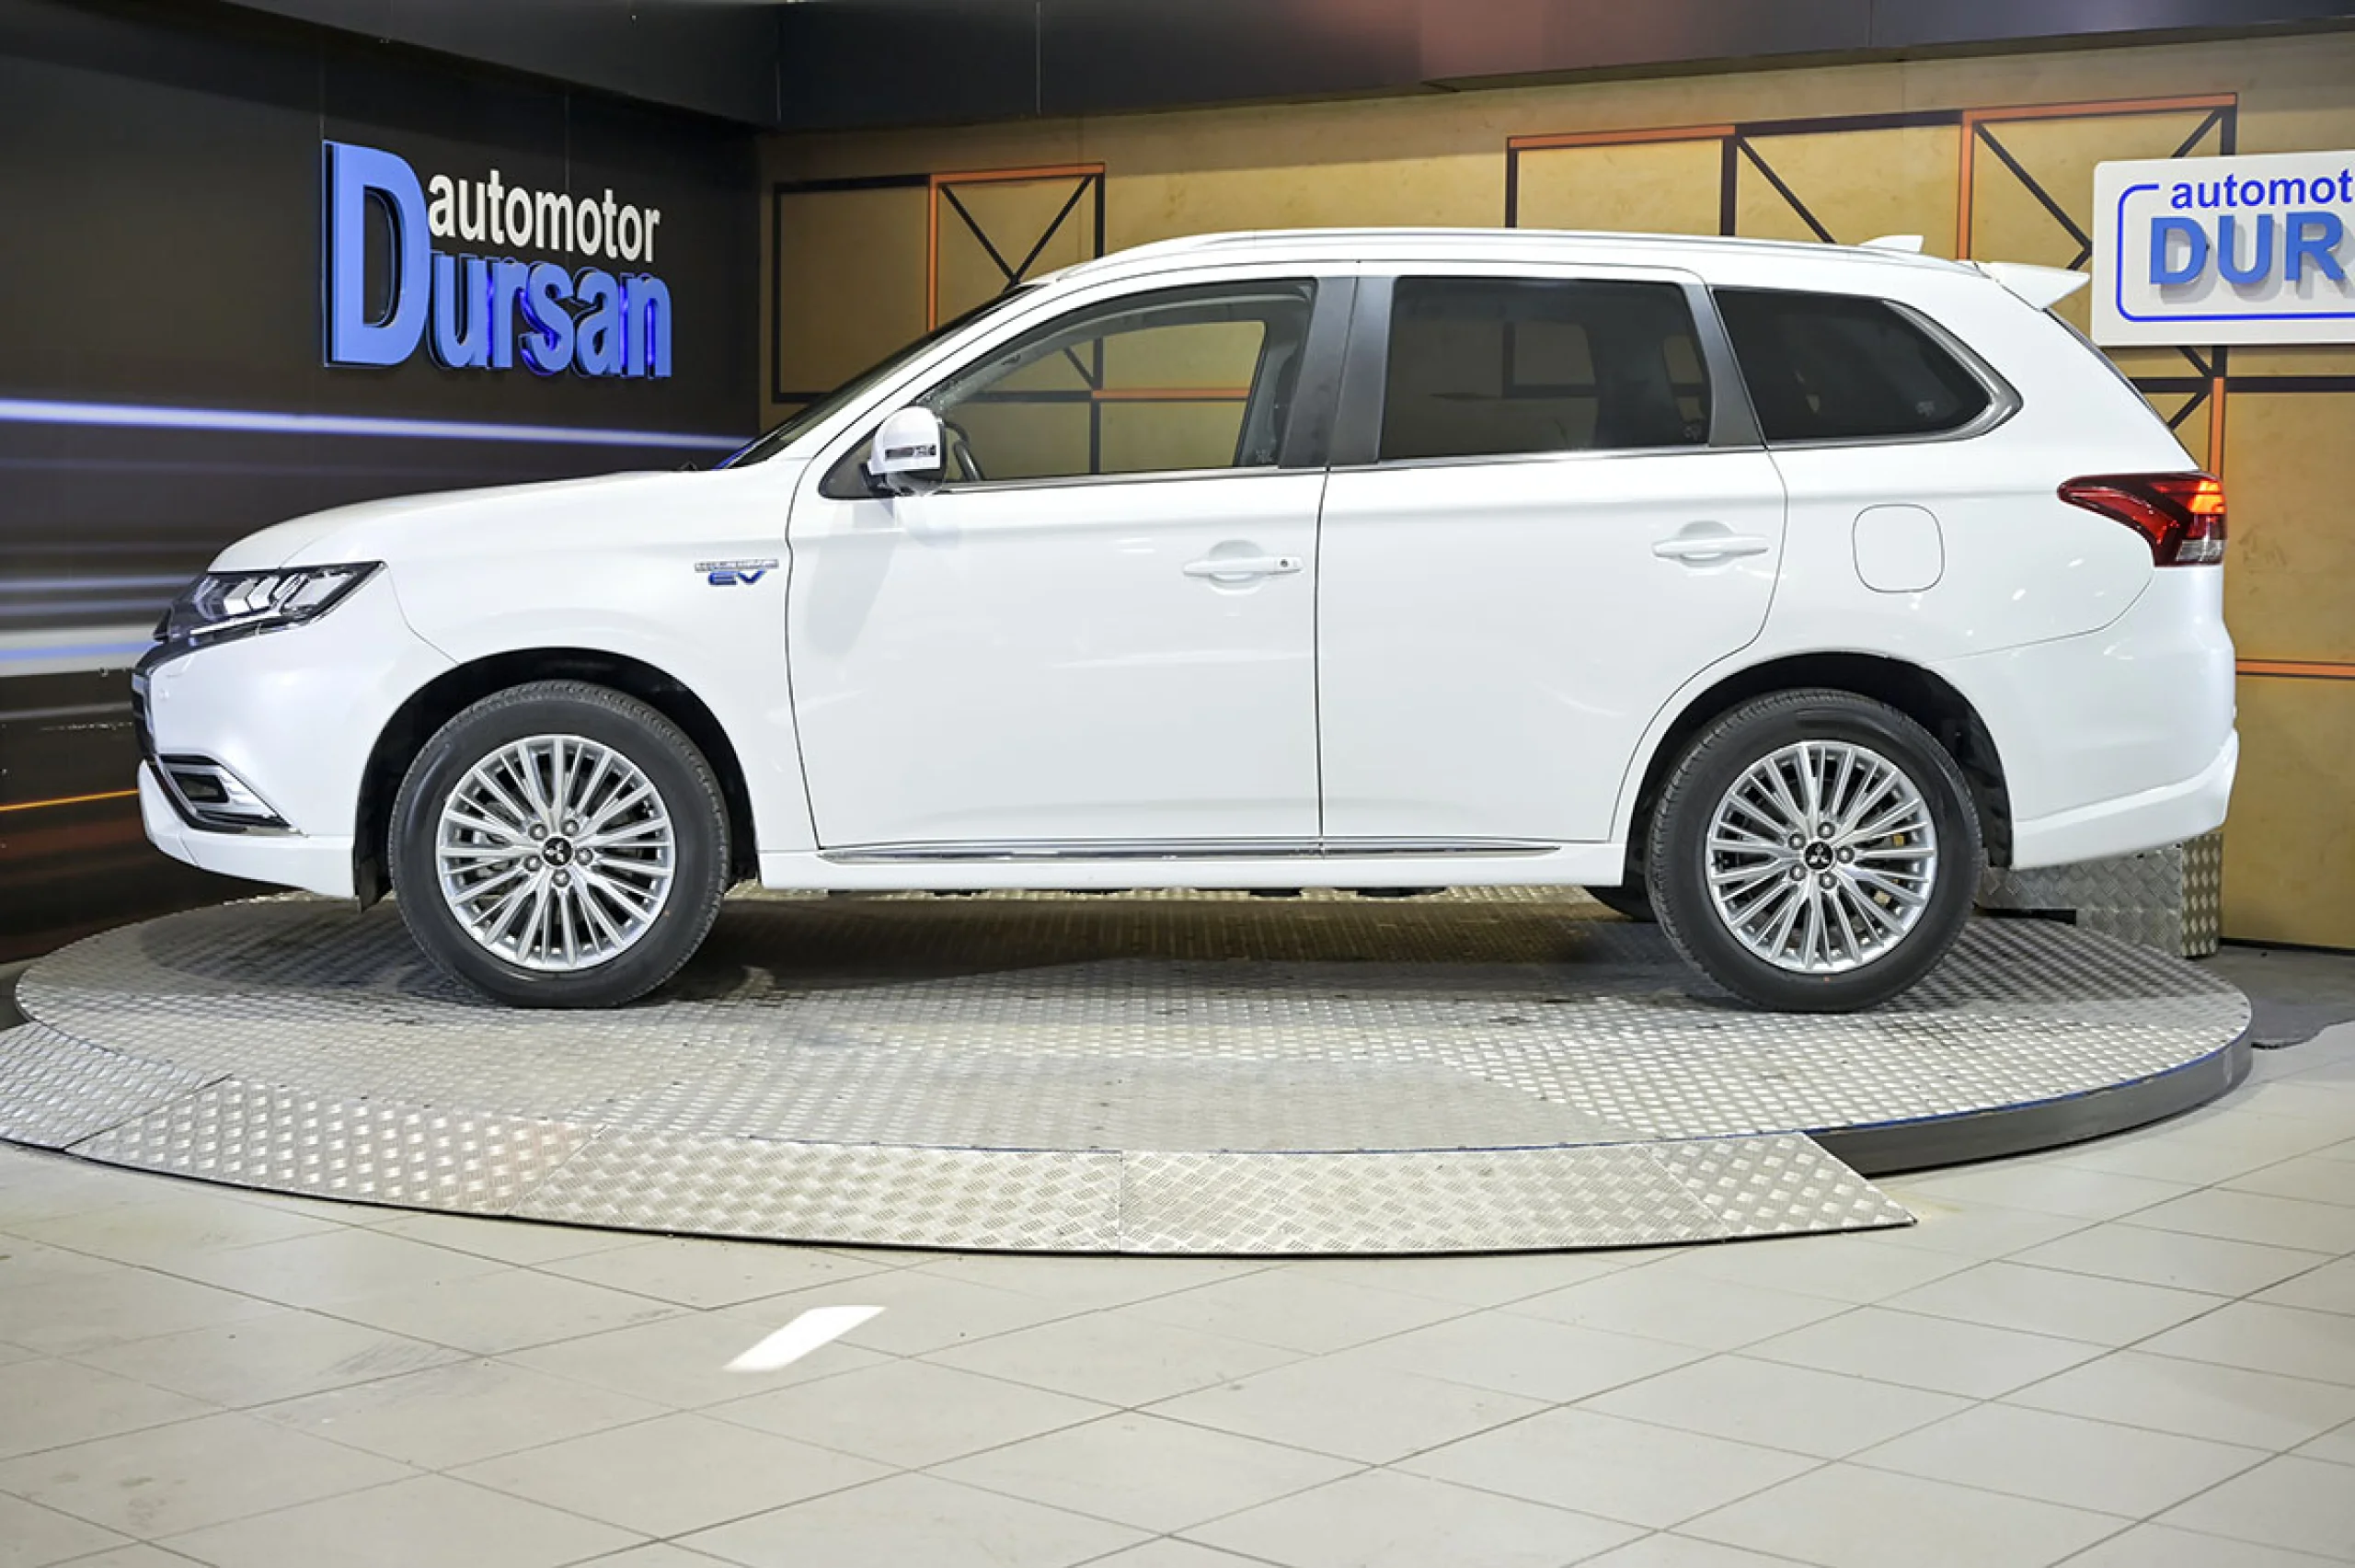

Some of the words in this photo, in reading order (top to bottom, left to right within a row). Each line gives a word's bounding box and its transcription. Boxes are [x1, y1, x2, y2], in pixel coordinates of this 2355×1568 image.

[428, 168, 661, 263] automotor
[2170, 169, 2353, 209] automot
[323, 140, 672, 379] Dursan
[2149, 212, 2345, 285] DUR
